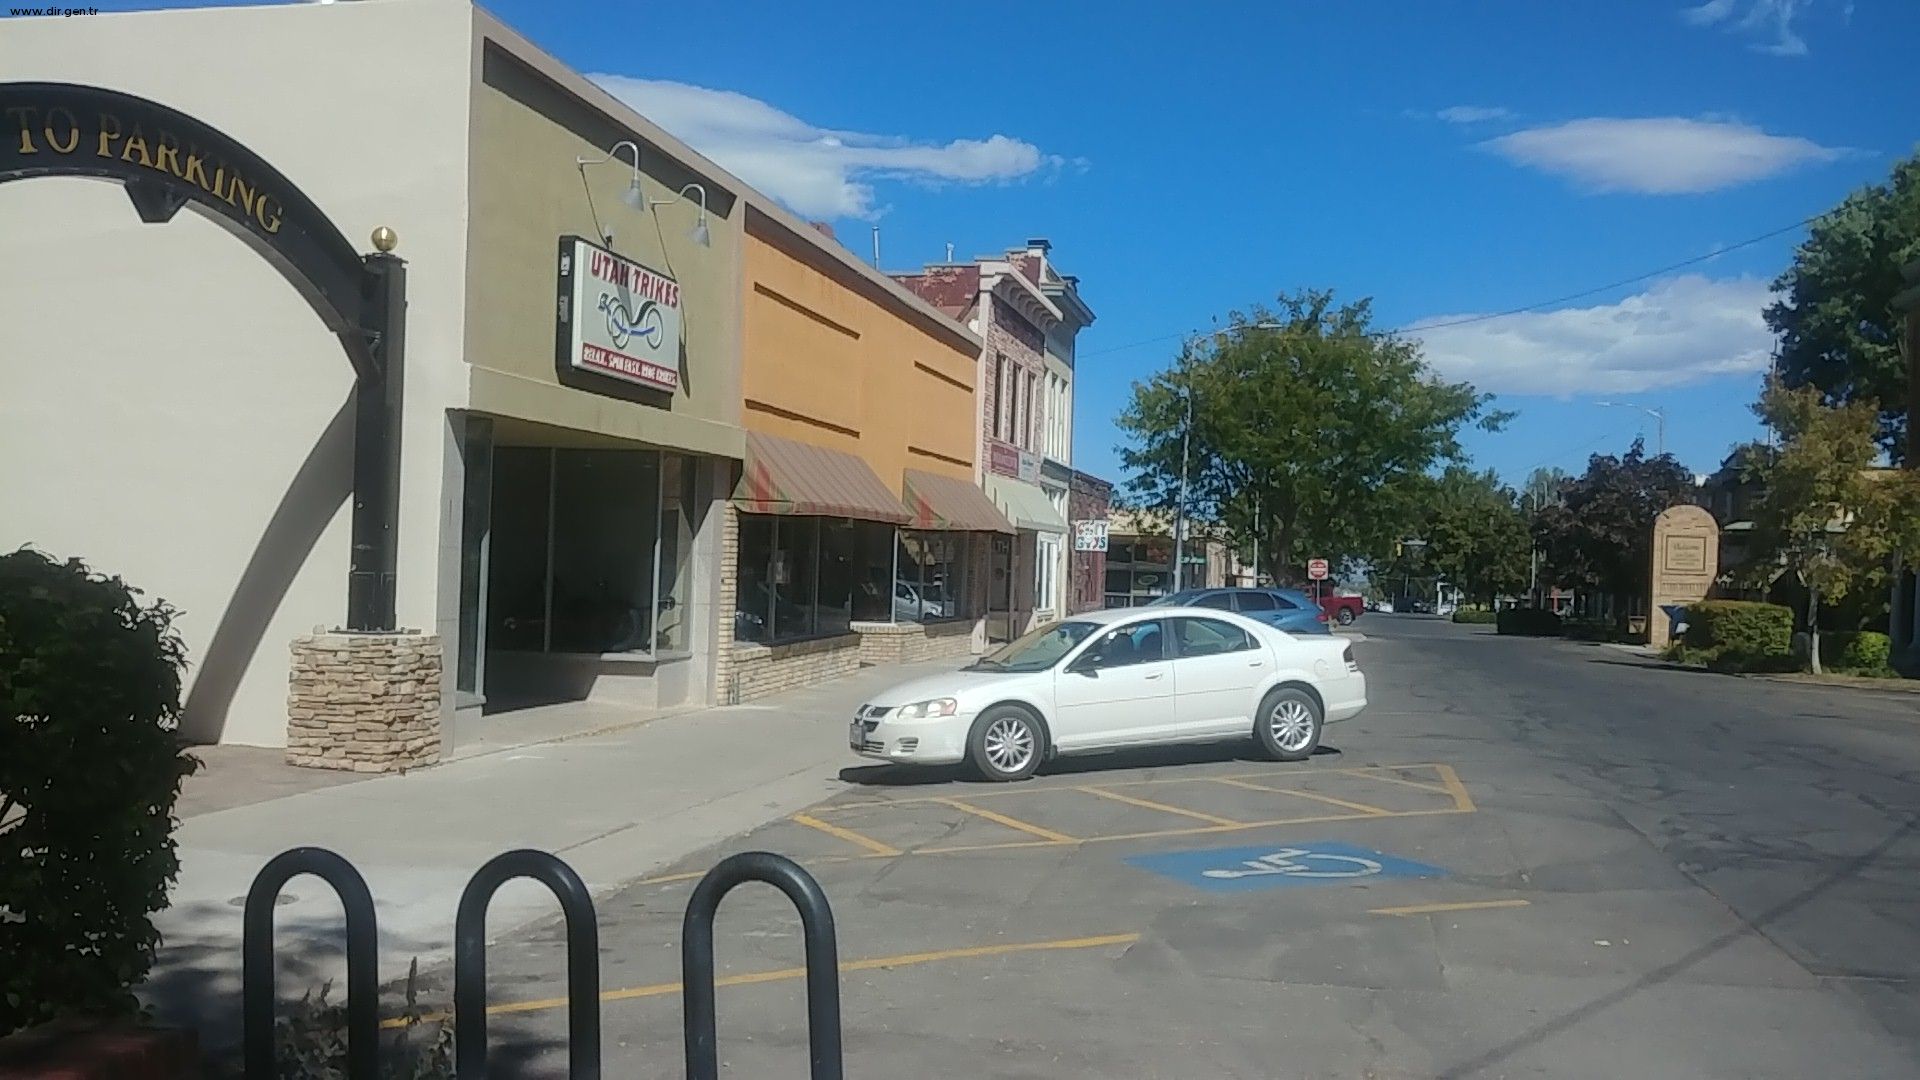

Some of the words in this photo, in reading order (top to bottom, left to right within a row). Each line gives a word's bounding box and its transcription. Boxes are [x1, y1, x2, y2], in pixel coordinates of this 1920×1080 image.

[6, 106, 80, 154] TO
[97, 113, 283, 233] PARKING
[591, 250, 630, 288] UTAH
[632, 268, 680, 309] TRIKES
